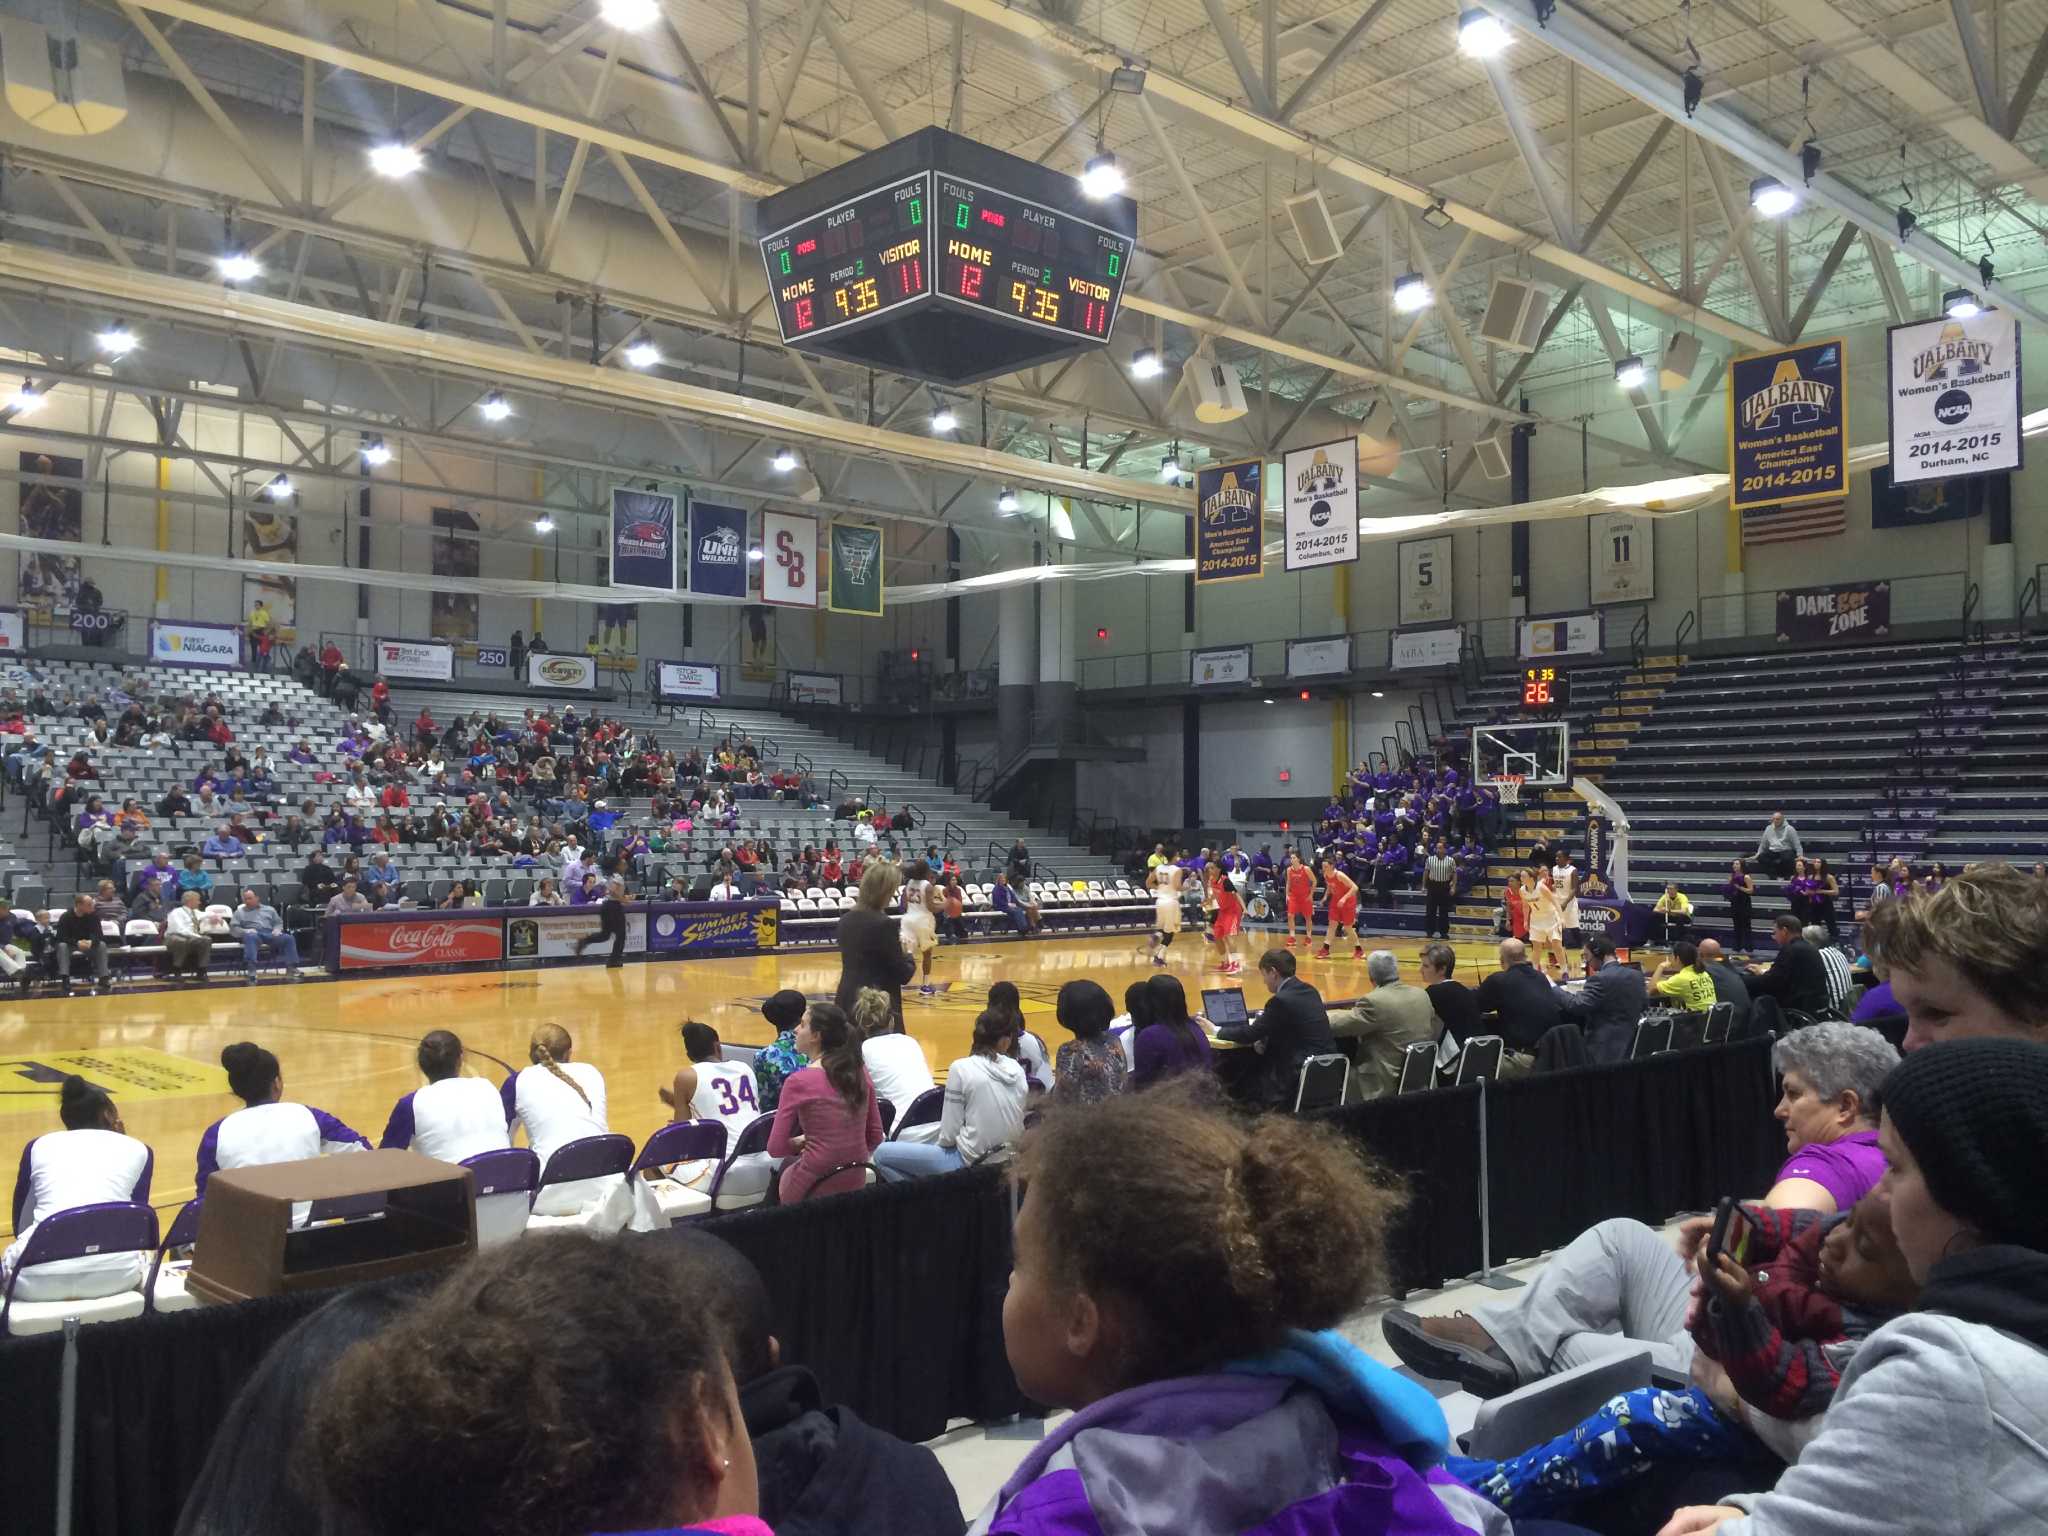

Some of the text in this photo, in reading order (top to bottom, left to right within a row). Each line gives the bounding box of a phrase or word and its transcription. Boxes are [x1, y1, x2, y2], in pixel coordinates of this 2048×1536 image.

[894, 183, 921, 203] FOULS
[943, 182, 975, 203] FOULS
[827, 209, 855, 229] PLAYER
[909, 199, 922, 225] 0
[955, 203, 969, 229] 0
[1023, 208, 1056, 229] PLAYER
[767, 237, 790, 253] FOULS
[879, 239, 920, 266] VISITOR
[948, 239, 992, 266] HOME
[1098, 235, 1124, 253] FOULS
[780, 251, 791, 275] 0
[830, 260, 865, 282] PERIOD 2
[1011, 262, 1052, 284] PERIOD 2
[1108, 253, 1120, 277] 0
[902, 260, 922, 293] 11
[961, 265, 983, 298] 12
[782, 278, 816, 302] HOME
[835, 277, 880, 316] 9:35
[1068, 277, 1110, 301] VISITOR
[1012, 281, 1060, 322] 9:35
[795, 298, 814, 330] 12
[1086, 302, 1105, 332] 11
[1912, 341, 1994, 379] UALBANY
[1898, 370, 2011, 397] Women's Basketball
[1741, 380, 1834, 428] UALBANY
[1937, 404, 1970, 418] NCAA
[1739, 426, 1838, 450] Women's Basketball
[1909, 433, 2001, 458] 2014-2015
[1755, 443, 1823, 461] America East
[1760, 455, 1815, 469] Champions
[1921, 452, 1990, 469] Durham, NC
[1297, 463, 1344, 492] UALBANY
[1742, 465, 1836, 492] 2014-2015
[1203, 488, 1256, 522] UALBANY
[1294, 488, 1348, 504] Men's Basketball
[1223, 526, 1254, 536] Basketball
[1295, 533, 1348, 551] 2014-2015
[703, 540, 738, 557] UNH
[1334, 547, 1345, 555] OH
[1613, 536, 1629, 562] 11
[1202, 554, 1257, 572] 2014-2015
[1419, 562, 1432, 586] 5
[72, 613, 108, 629] 200
[1829, 606, 1869, 636] ZONE
[183, 643, 233, 655] NIAGARA
[480, 651, 504, 665] 250
[1526, 683, 1548, 703] 26
[1590, 827, 1599, 869] MOHAWK
[1578, 910, 1611, 921] HAWK
[1578, 921, 1605, 931] onda
[389, 923, 456, 950] Coca-Cola
[1690, 976, 1713, 989] EVEN
[711, 1074, 759, 1115] 34
